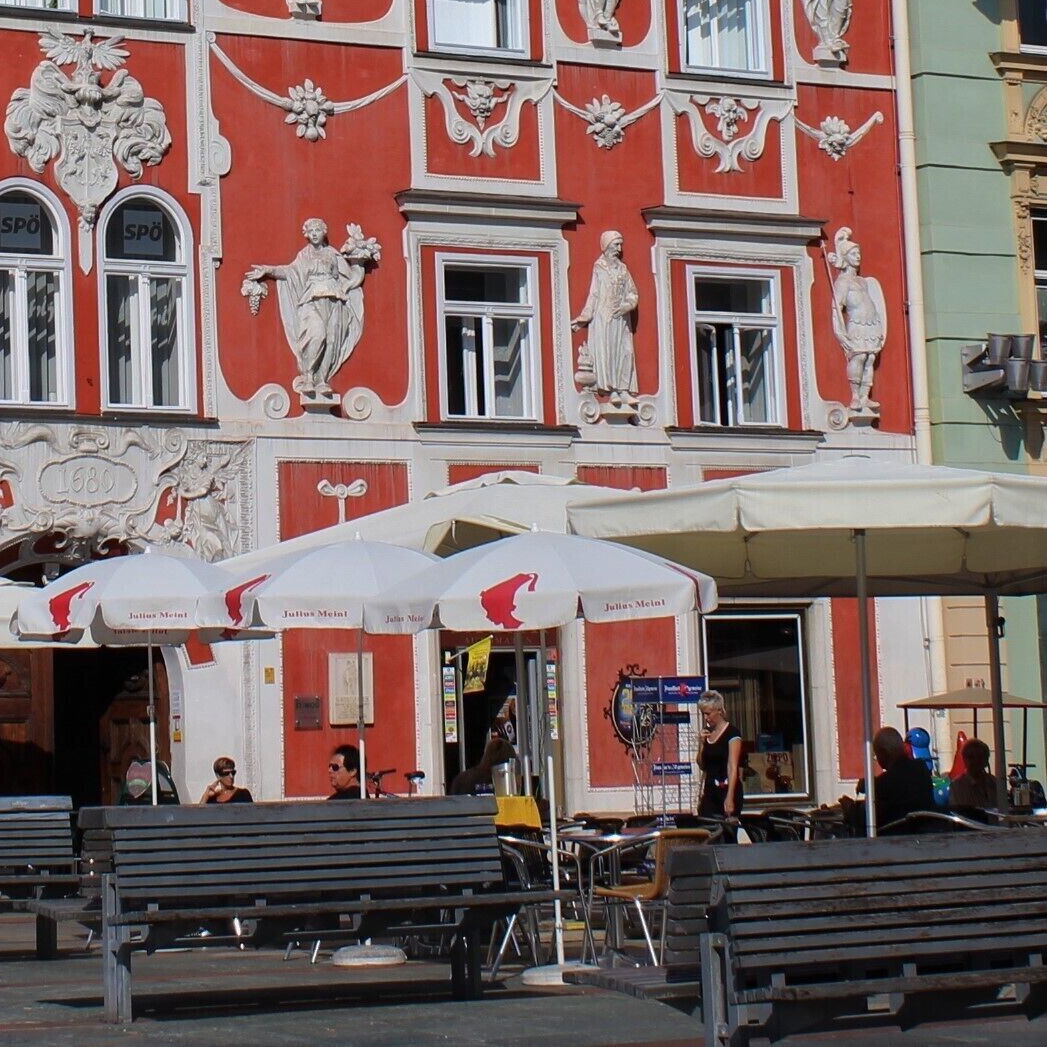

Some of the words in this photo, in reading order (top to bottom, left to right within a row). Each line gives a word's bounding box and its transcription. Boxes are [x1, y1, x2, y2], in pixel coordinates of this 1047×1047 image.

[0, 214, 40, 235] SPÖ
[124, 221, 163, 242] SPÖ
[603, 602, 633, 612] Julius
[129, 612, 156, 620] Julius
[282, 609, 315, 619] Julius
